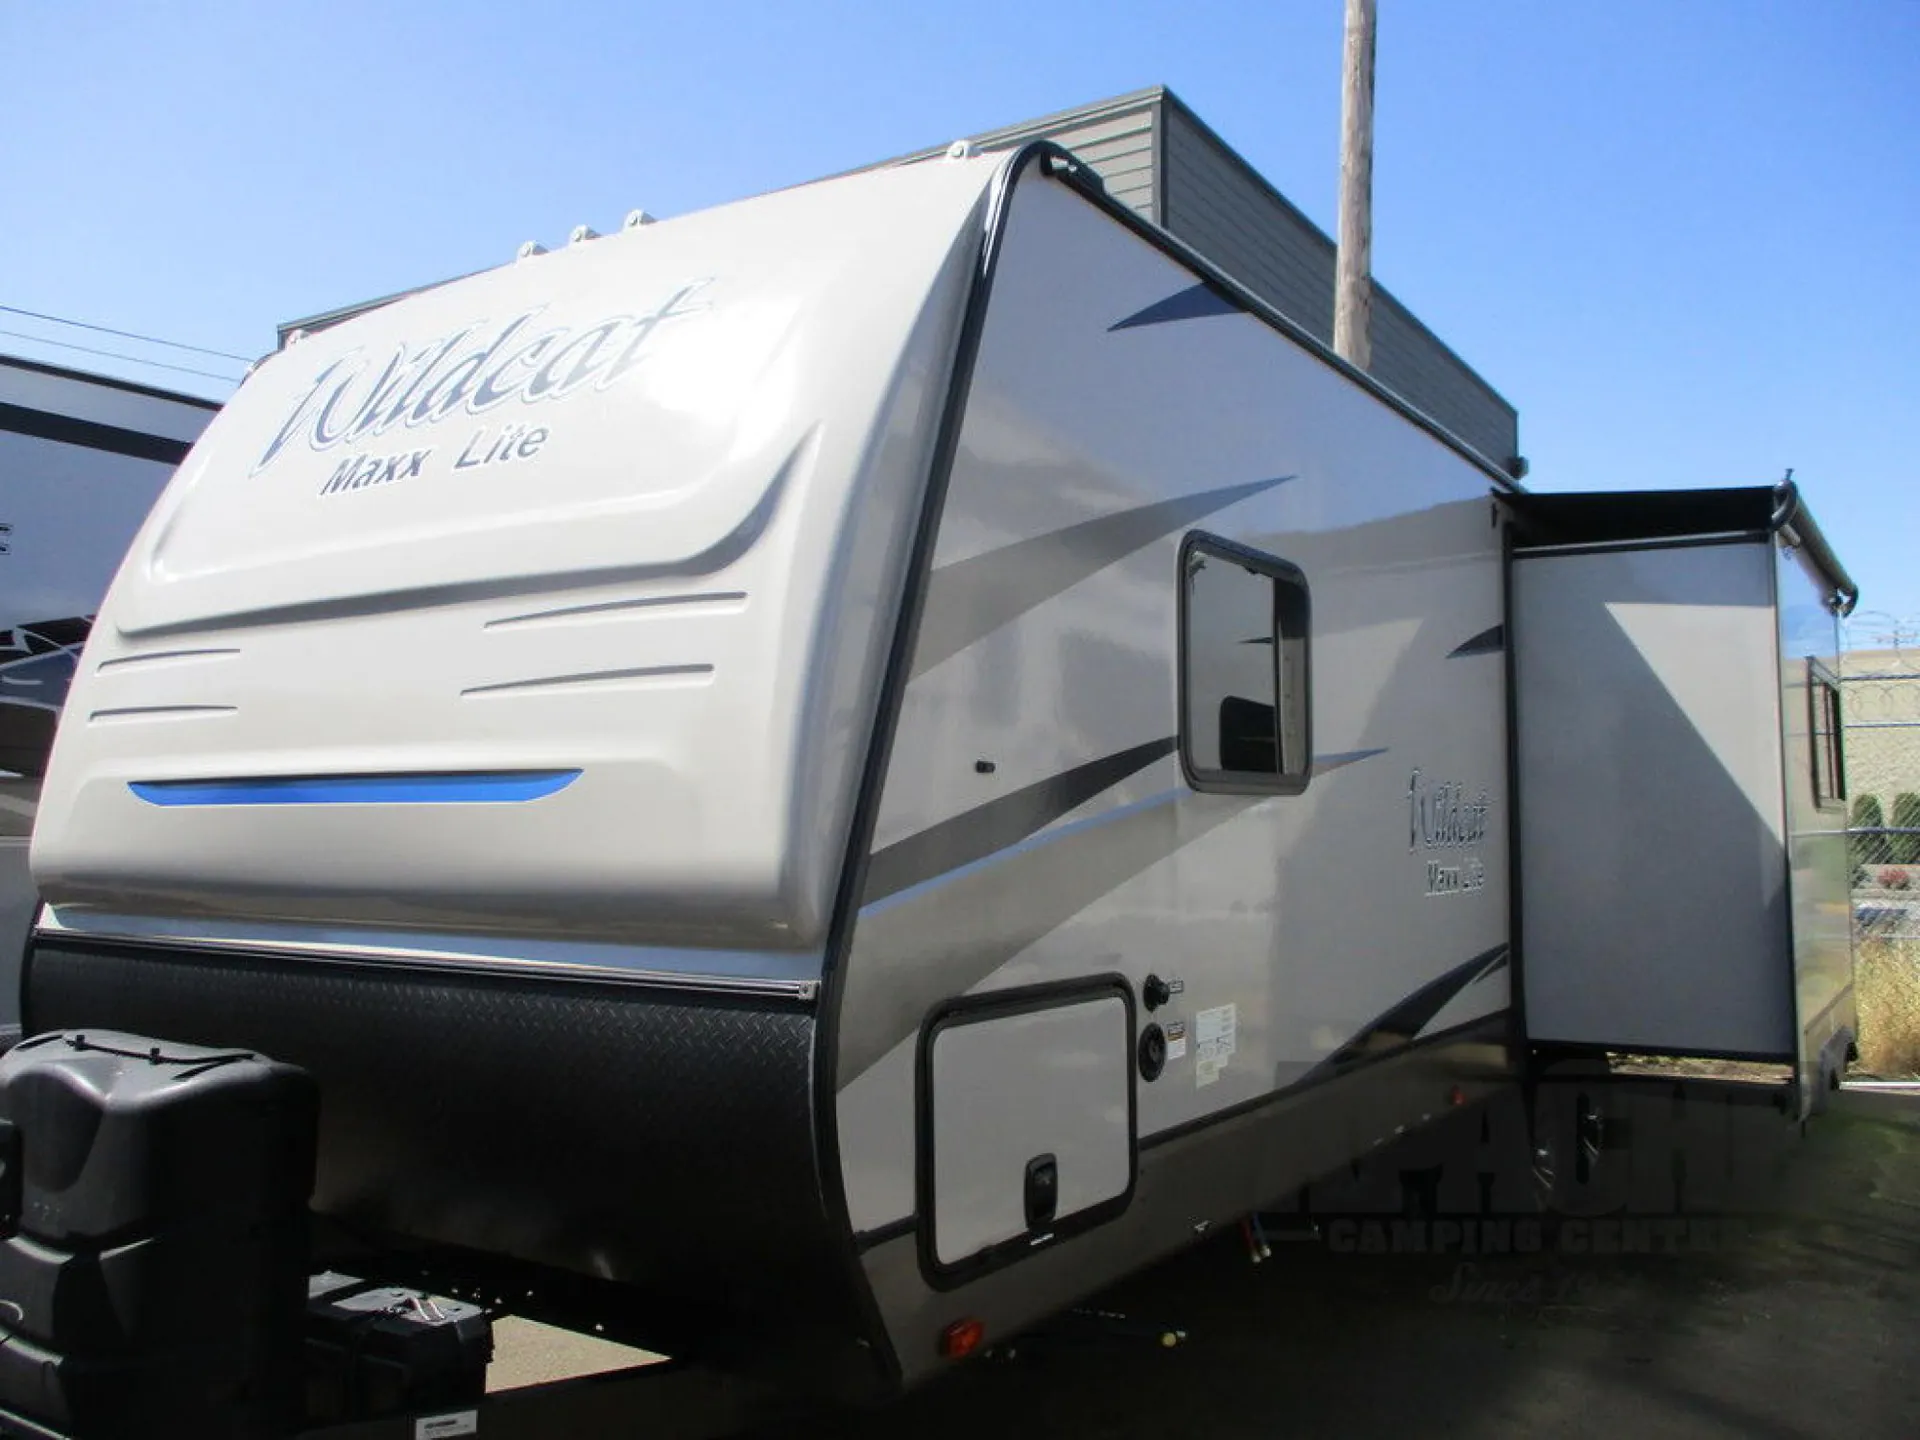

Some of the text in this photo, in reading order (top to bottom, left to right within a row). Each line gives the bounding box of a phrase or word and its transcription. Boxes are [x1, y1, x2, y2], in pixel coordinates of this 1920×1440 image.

[248, 277, 715, 480] Wildcat
[319, 423, 550, 496] Maxx Lite
